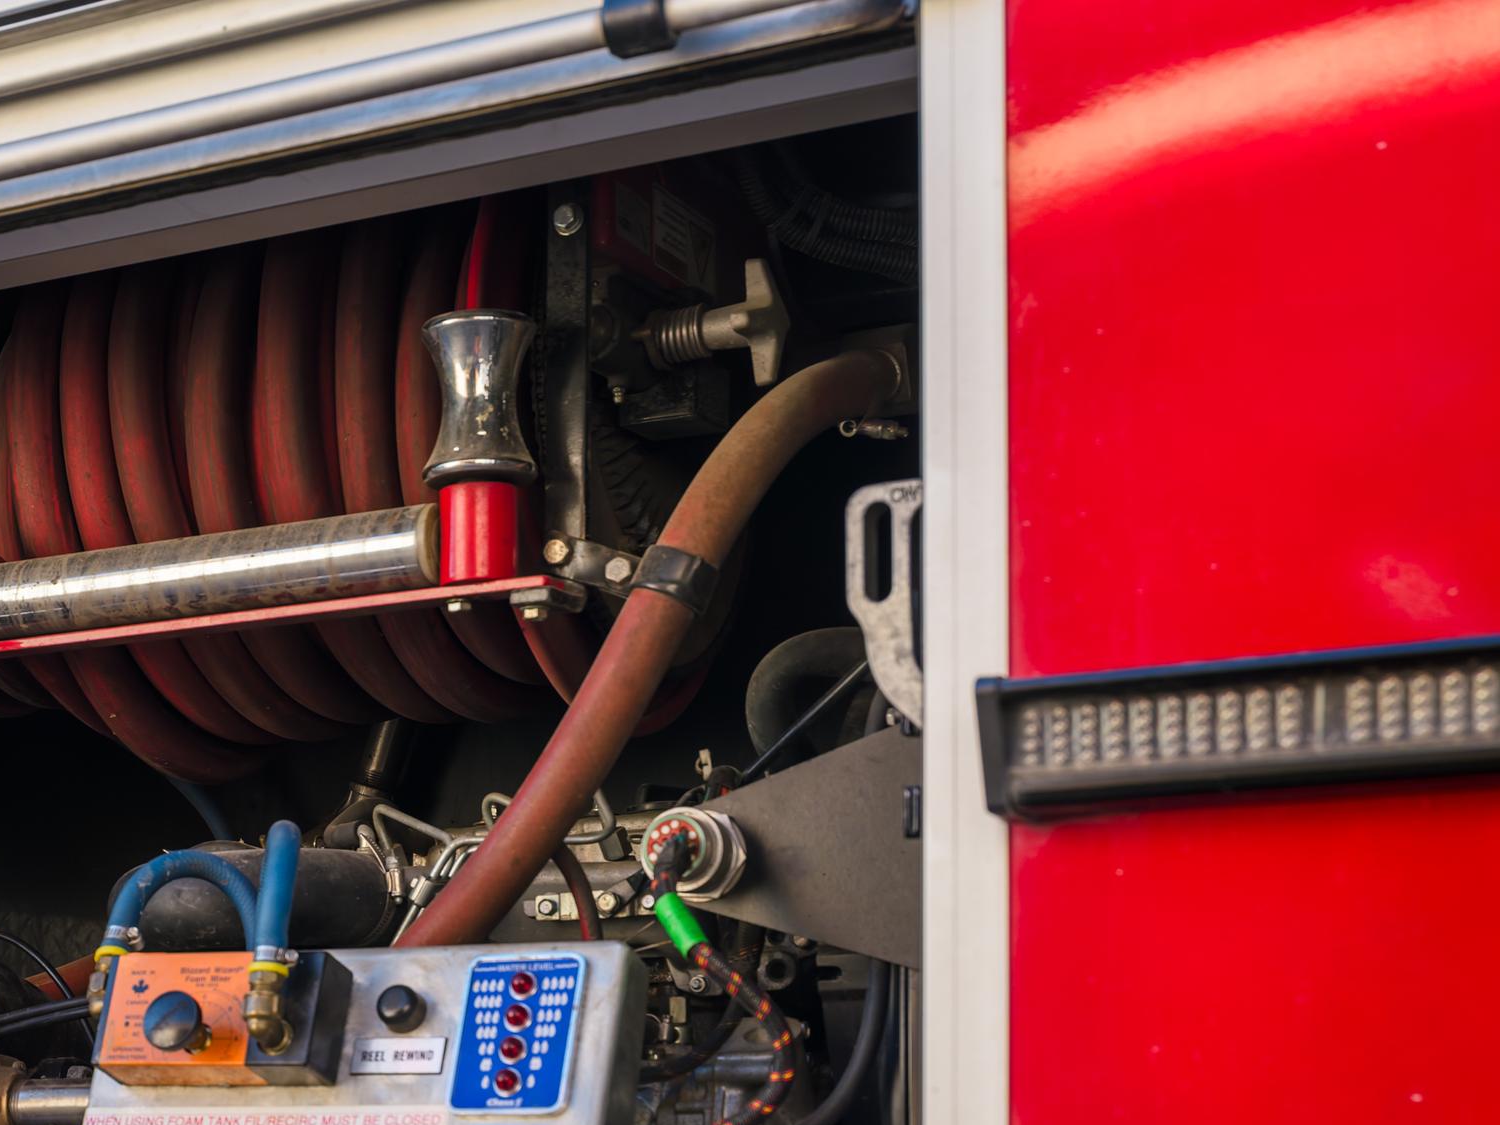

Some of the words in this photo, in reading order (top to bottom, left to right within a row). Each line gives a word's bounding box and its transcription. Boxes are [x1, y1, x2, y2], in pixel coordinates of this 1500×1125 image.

[496, 963, 527, 972] WATER
[528, 963, 555, 971] LEVEL
[361, 1050, 386, 1062] REEL
[393, 1049, 434, 1061] REWIND
